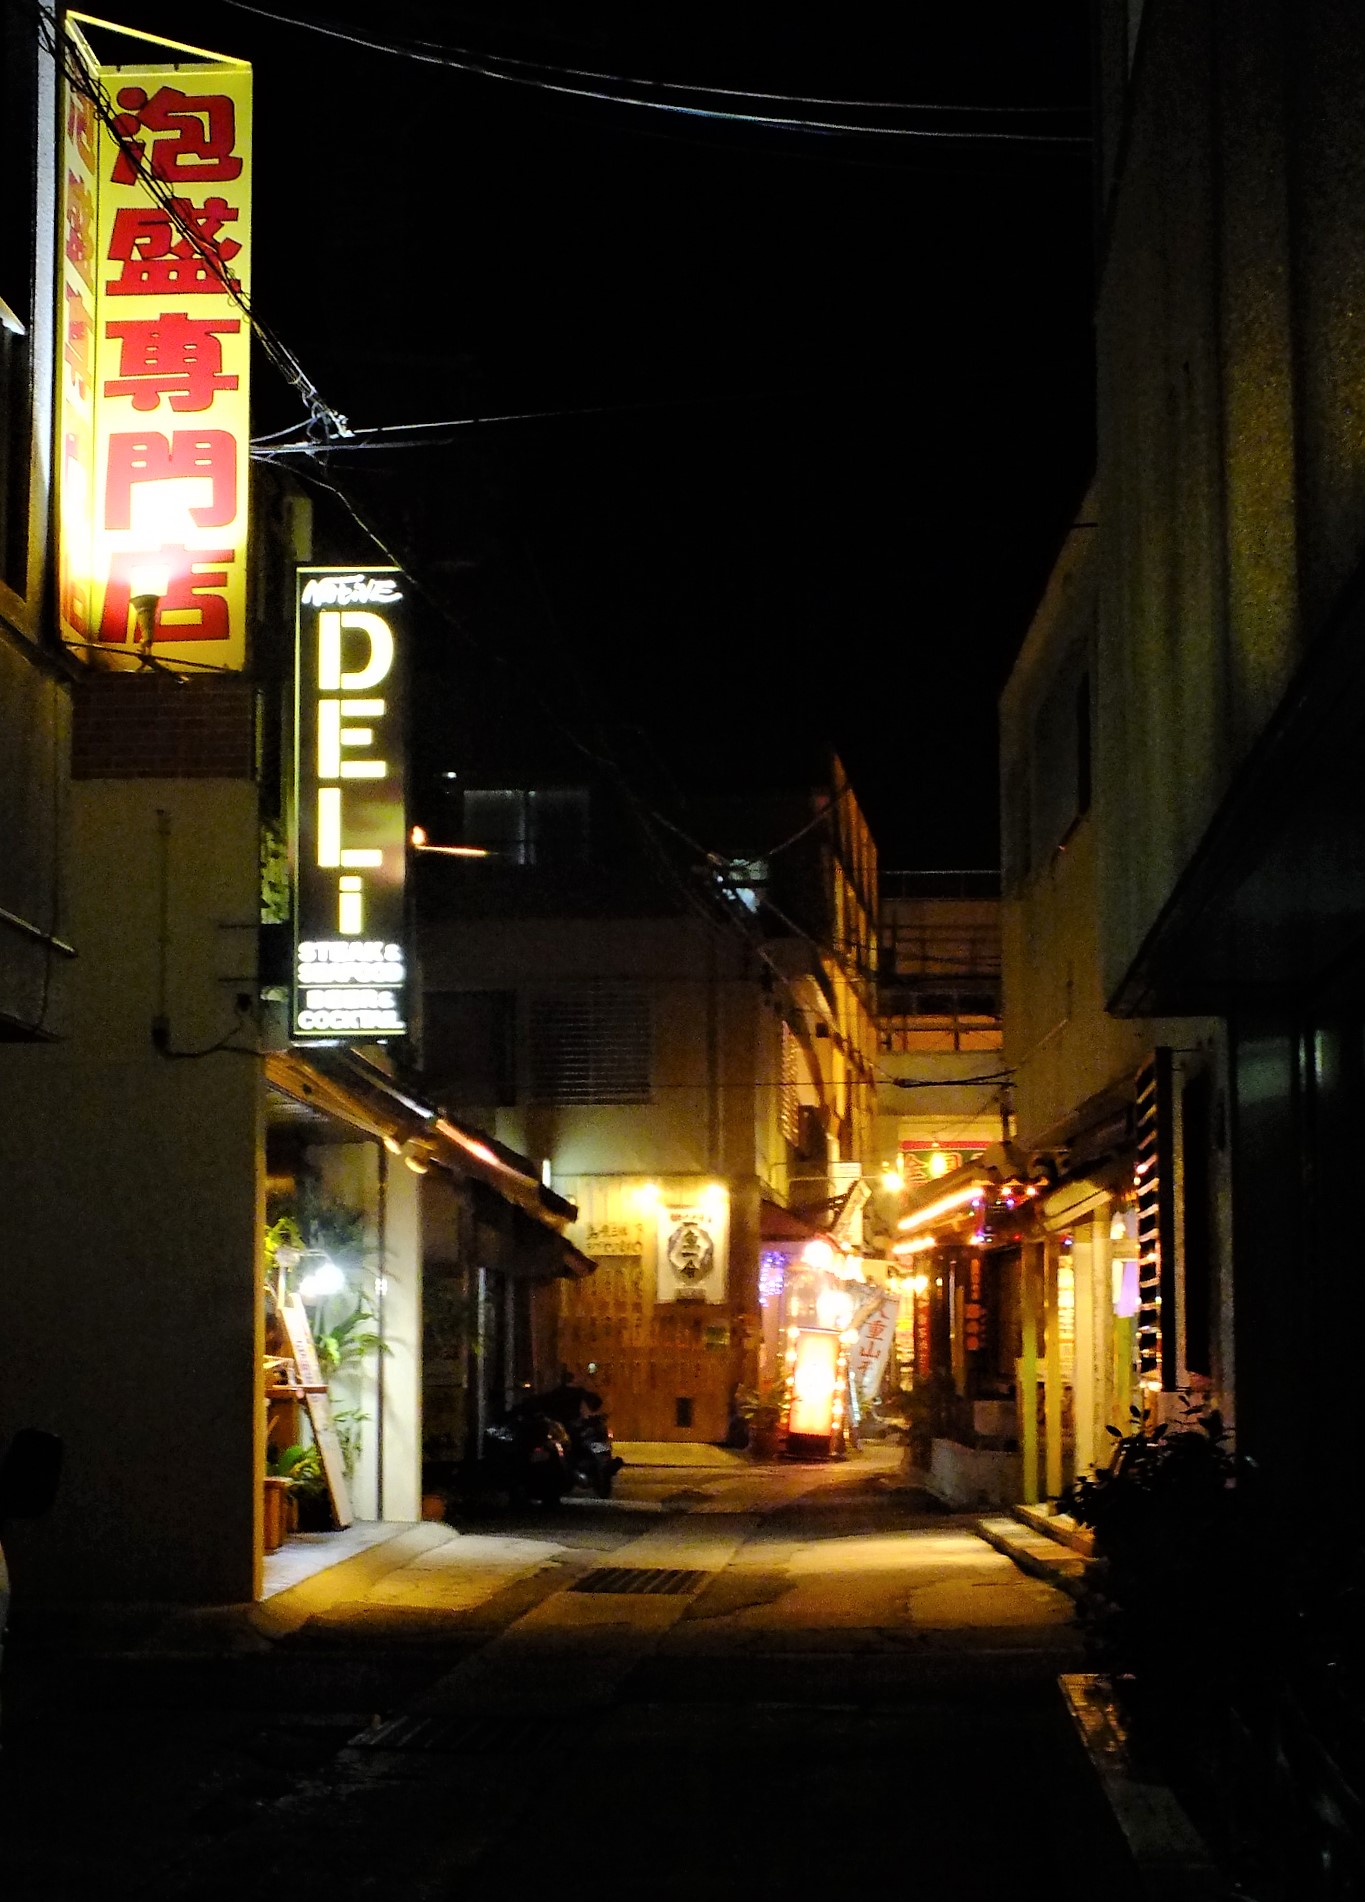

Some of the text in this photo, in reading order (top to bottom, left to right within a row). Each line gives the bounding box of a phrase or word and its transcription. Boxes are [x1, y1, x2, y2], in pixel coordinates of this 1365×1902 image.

[101, 86, 243, 643] 泡盛専門店
